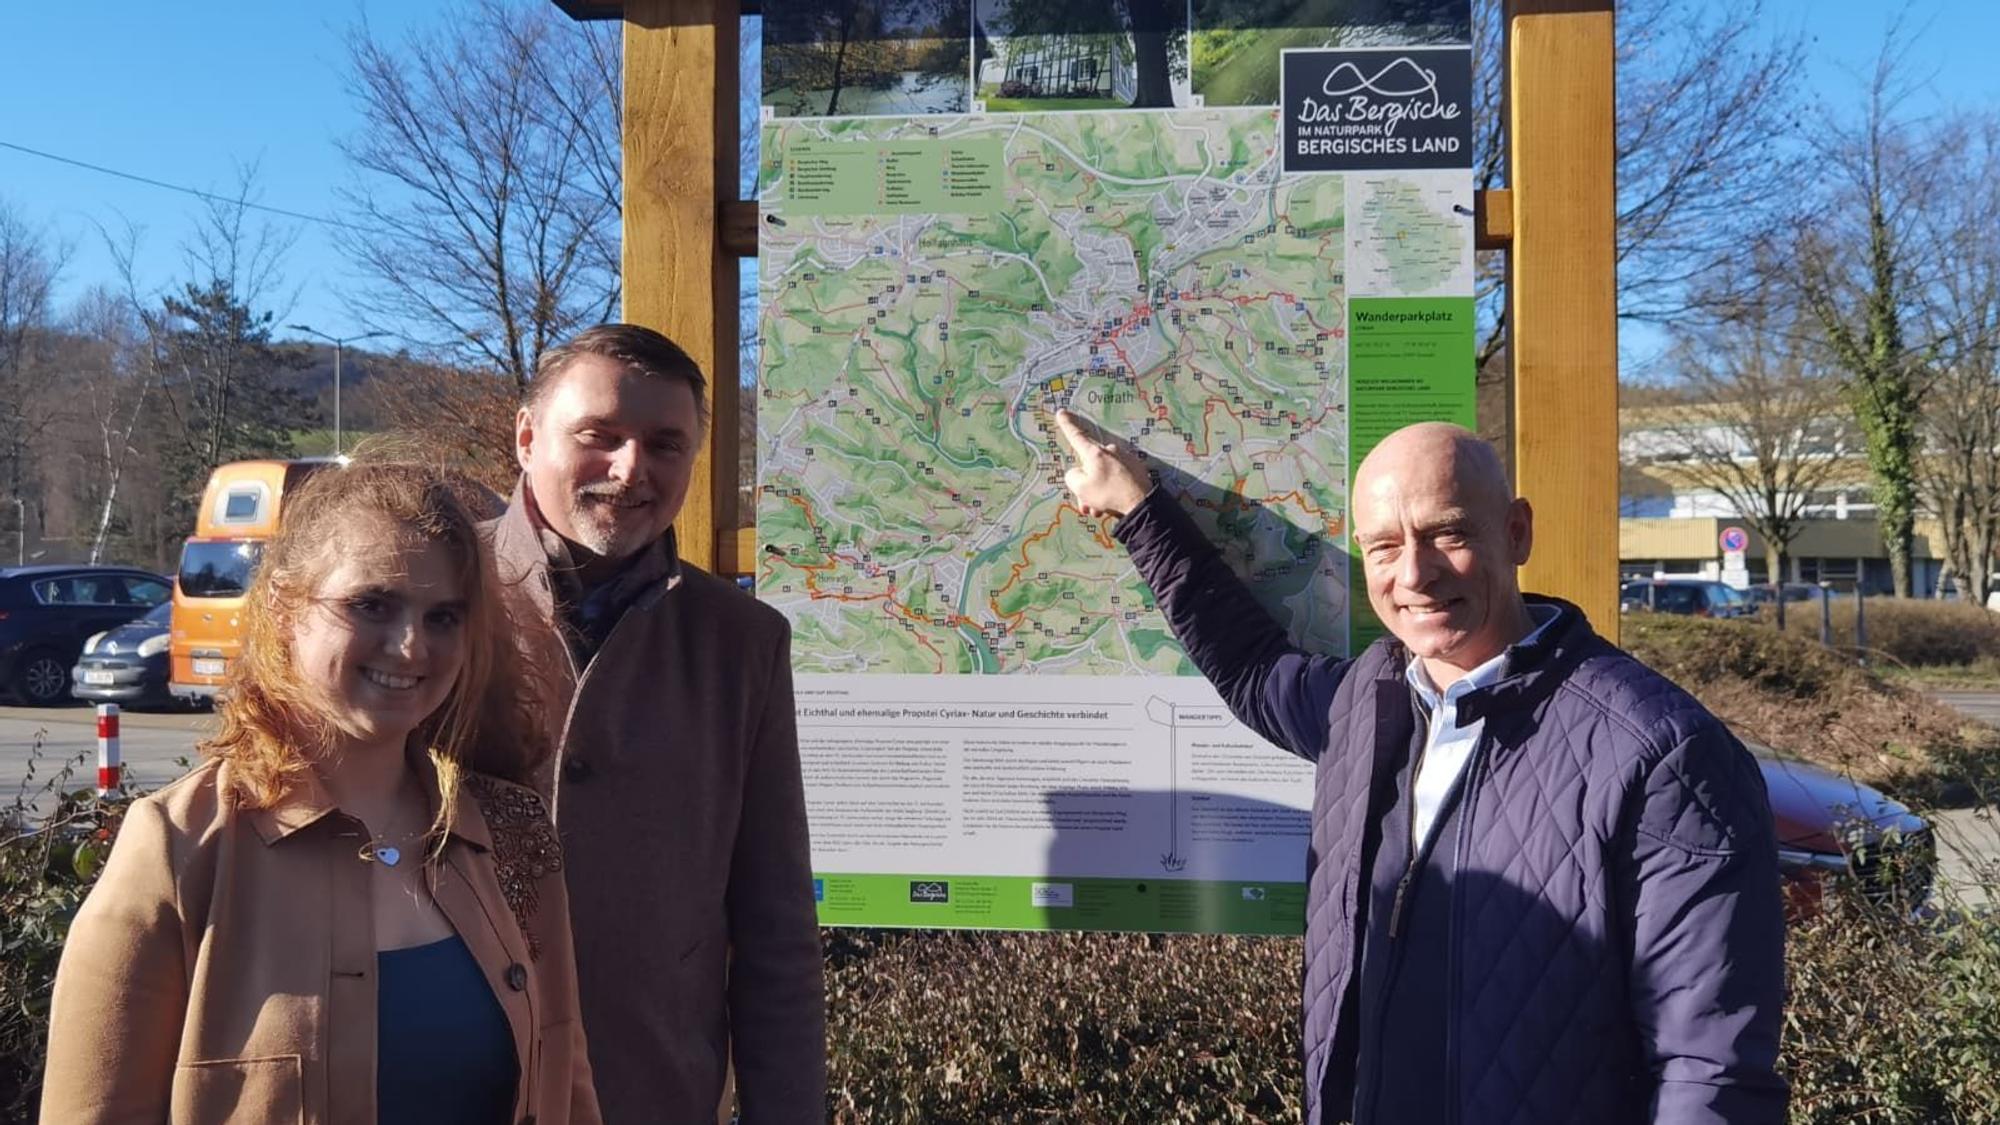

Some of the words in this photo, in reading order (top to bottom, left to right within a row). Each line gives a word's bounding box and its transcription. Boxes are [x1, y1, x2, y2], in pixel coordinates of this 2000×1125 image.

[1298, 97, 1341, 122] Das
[1345, 96, 1461, 136] Bergische
[1298, 127, 1312, 136] IM
[1314, 125, 1383, 136] NATURPARK
[1298, 138, 1407, 154] BERGISCHES
[1412, 137, 1460, 152] LAND
[1355, 310, 1454, 324] Wanderparkplatz
[1087, 390, 1134, 403] Overath
[840, 708, 855, 717] und
[857, 708, 900, 719] ehemalige
[972, 710, 996, 718] Natur
[998, 710, 1015, 718] und
[1017, 710, 1065, 719] Geschichte
[1067, 710, 1108, 719] verbindet
